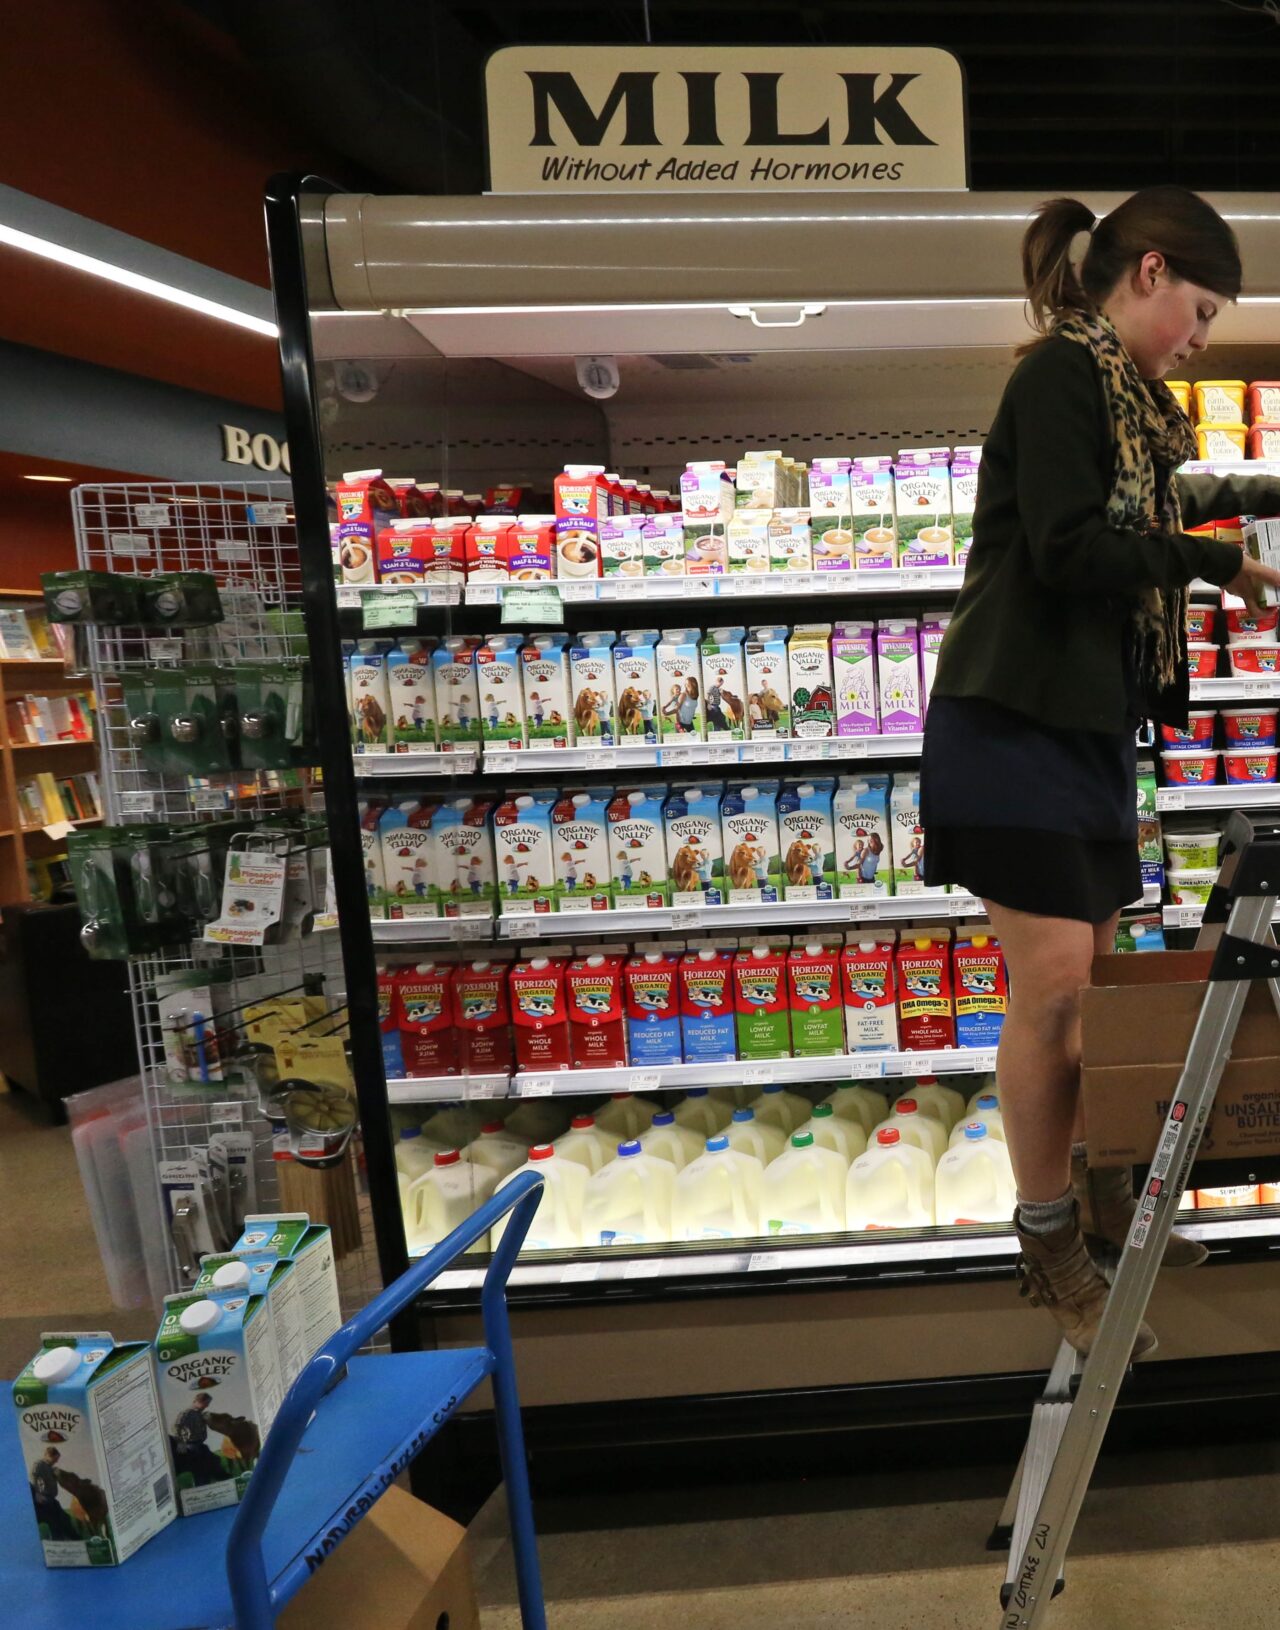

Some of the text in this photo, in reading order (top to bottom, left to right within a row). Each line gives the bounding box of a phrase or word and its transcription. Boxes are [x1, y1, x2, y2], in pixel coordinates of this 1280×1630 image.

[524, 71, 938, 147] MILK
[541, 156, 905, 182] Without Added Hormones
[900, 480, 941, 492] ORGANIC
[813, 489, 845, 499] ORGANIC
[856, 488, 887, 498] ORGANIC
[905, 489, 938, 499] VALLEY
[705, 657, 736, 669] ORGANIC
[749, 656, 781, 667] ORGANIC
[791, 652, 824, 663] ORGANIC
[796, 658, 821, 667] VALLEY
[660, 658, 692, 672] ORGANIC
[840, 700, 870, 710] MILK
[885, 699, 915, 709] MILK
[727, 816, 770, 829] ORGANIC
[783, 814, 825, 827] ORGANIC
[839, 812, 881, 824] ORGANIC
[613, 824, 655, 836] ORGANIC
[670, 819, 713, 832] ORGANIC
[732, 825, 766, 835] VALLEY
[789, 823, 821, 832] VALLEY
[843, 820, 877, 831] VALLEY
[500, 828, 543, 841] ORGANIC
[558, 827, 600, 838] ORGANIC
[618, 831, 651, 841] VALLEY
[676, 828, 709, 838] VALLEY
[505, 836, 538, 845] VALLEY
[562, 834, 596, 843] VALLEY
[846, 961, 888, 973] HORIZON
[901, 959, 943, 970] HORIZON
[957, 956, 999, 968] HORIZON
[683, 970, 726, 981] HORIZON
[737, 966, 780, 978] HORIZON
[791, 964, 833, 976] HORIZON
[571, 976, 614, 987] HORIZON
[629, 972, 672, 983] HORIZON
[688, 979, 722, 987] ORGANIC
[795, 974, 829, 982] ORGANIC
[514, 978, 558, 990] HORIZON
[518, 989, 554, 997] ORGANIC
[917, 999, 949, 1007] Omega-3
[972, 997, 1004, 1005] Omega-3
[634, 1031, 662, 1039] REDUCED
[168, 1355, 237, 1378] ORGANIC
[176, 1366, 231, 1384] VALLEY
[22, 1410, 81, 1426] ORGANIC
[30, 1420, 76, 1433] VALLEY
[1014, 1555, 1040, 1609] COTTAGE
